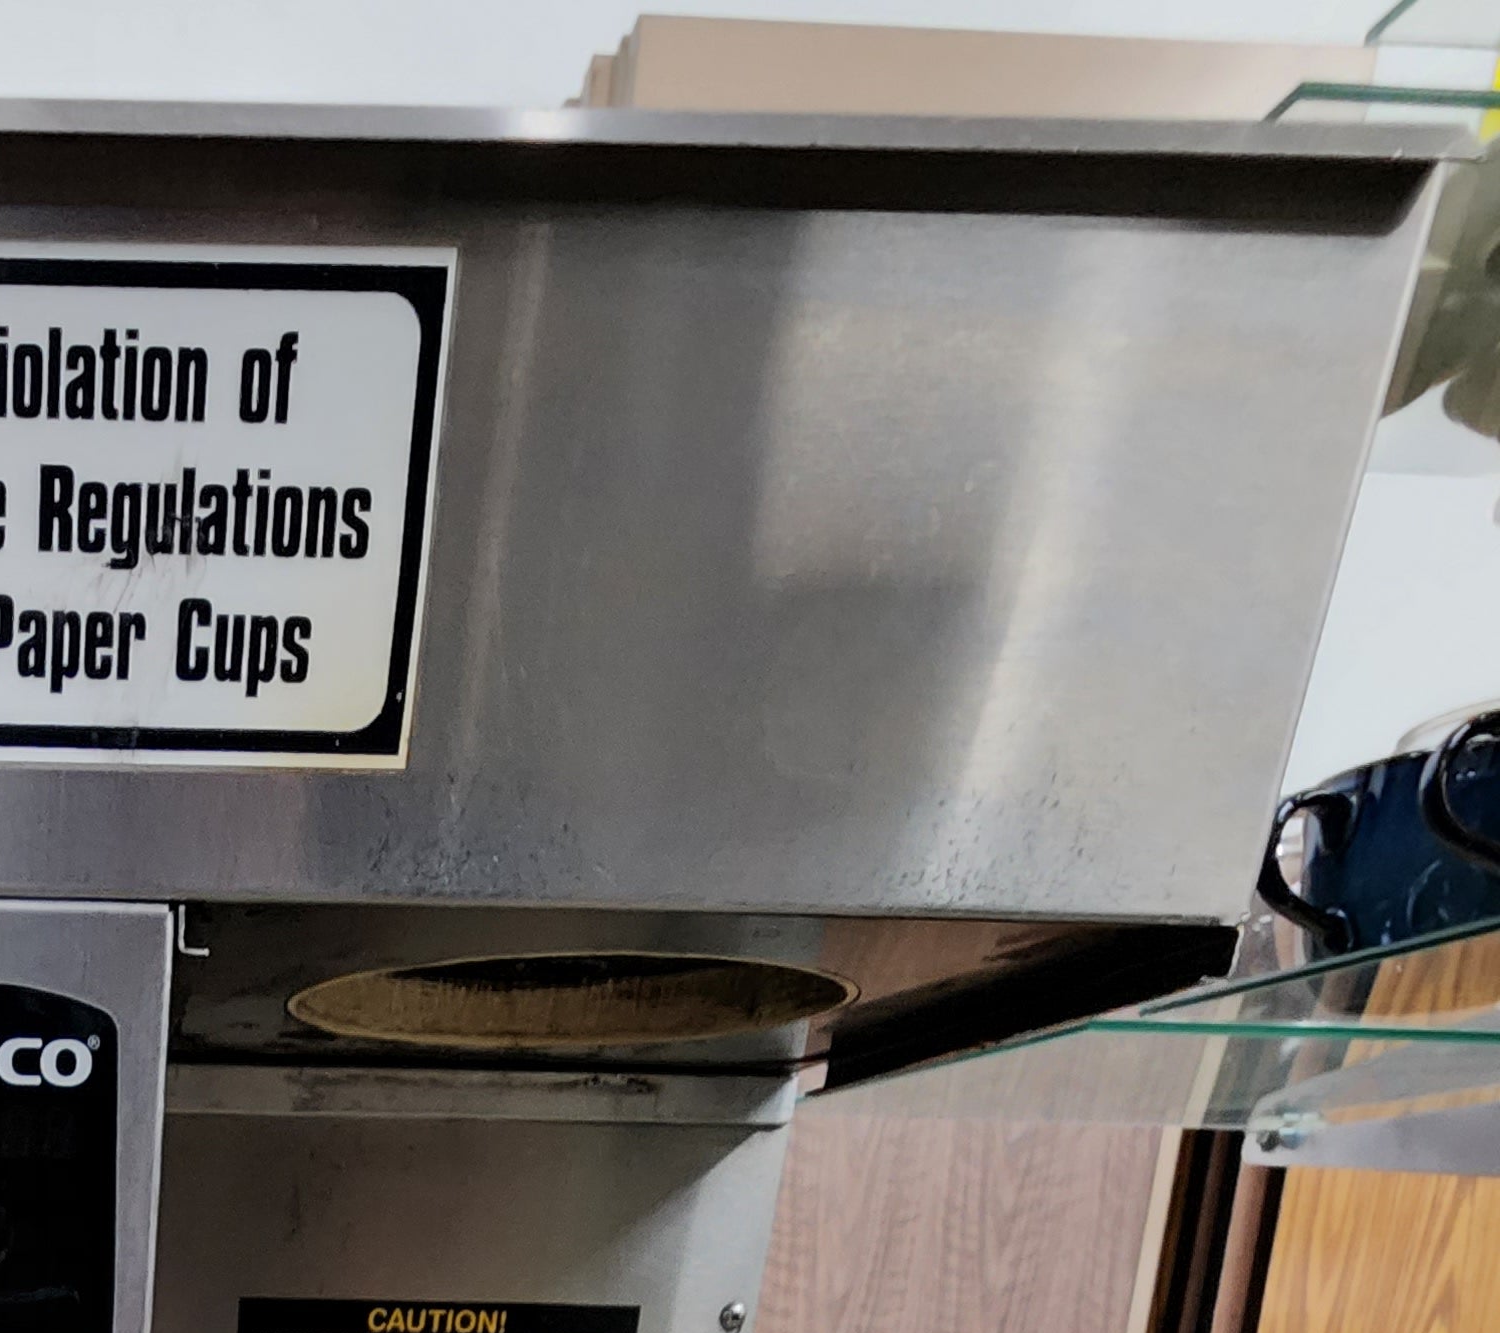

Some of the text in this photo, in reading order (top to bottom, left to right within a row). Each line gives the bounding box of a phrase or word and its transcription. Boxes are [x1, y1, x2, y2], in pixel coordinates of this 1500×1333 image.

[239, 331, 299, 424] of
[38, 464, 373, 569] Regulations
[175, 599, 313, 697] Cups
